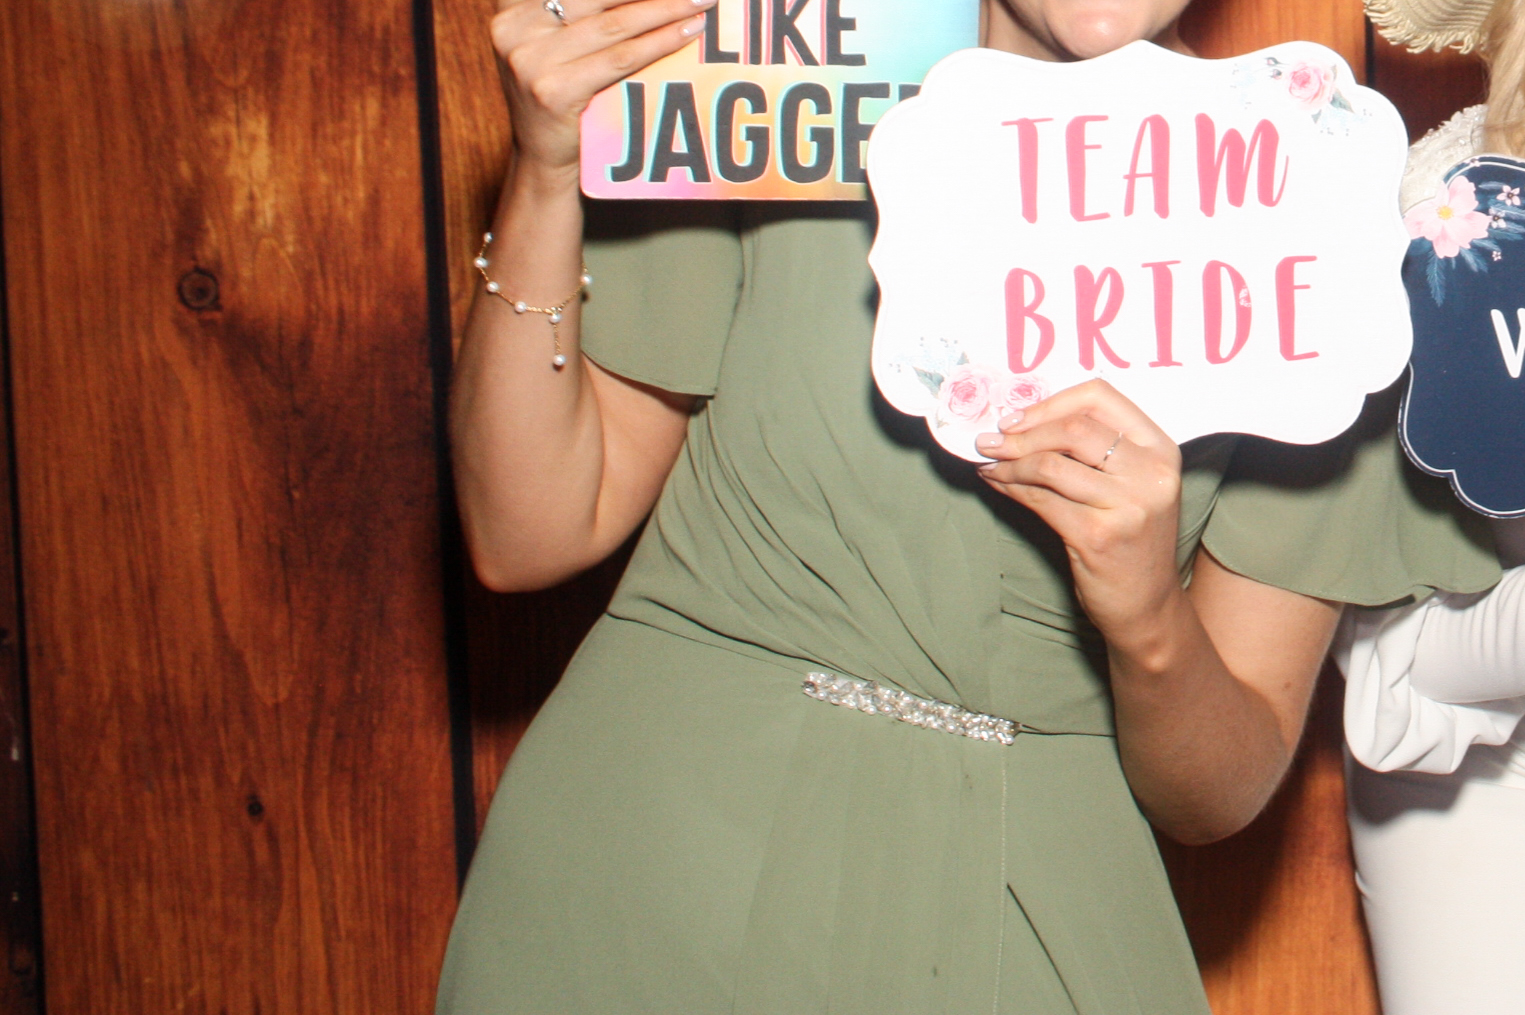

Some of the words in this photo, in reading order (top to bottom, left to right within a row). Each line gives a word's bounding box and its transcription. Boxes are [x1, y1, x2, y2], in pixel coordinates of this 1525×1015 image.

[604, 80, 921, 185] JAGGE
[1001, 112, 1290, 224] TEAM
[1003, 255, 1320, 374] BRIDE
